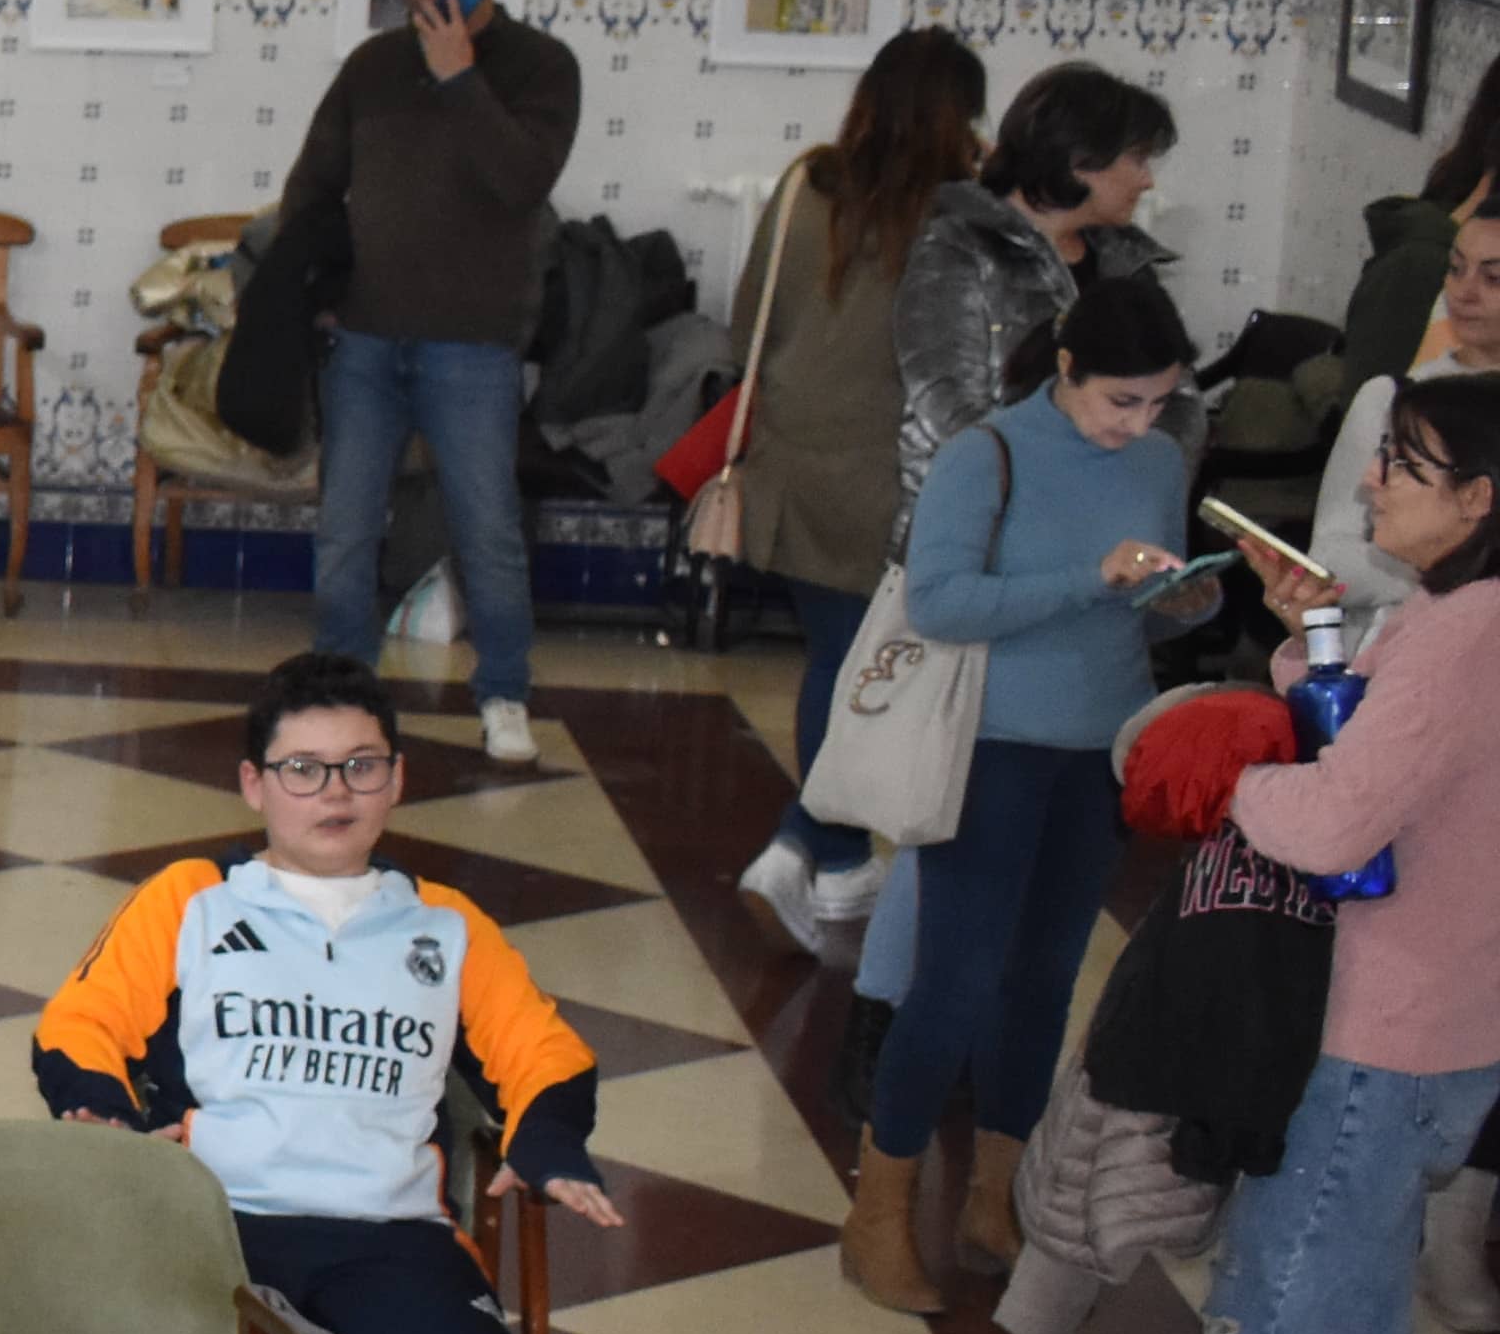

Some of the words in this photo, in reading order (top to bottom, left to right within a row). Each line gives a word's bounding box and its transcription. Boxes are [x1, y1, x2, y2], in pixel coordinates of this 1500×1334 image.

[212, 991, 436, 1059] Emirates
[244, 1042, 297, 1082] FLY
[303, 1048, 404, 1097] BETTER
